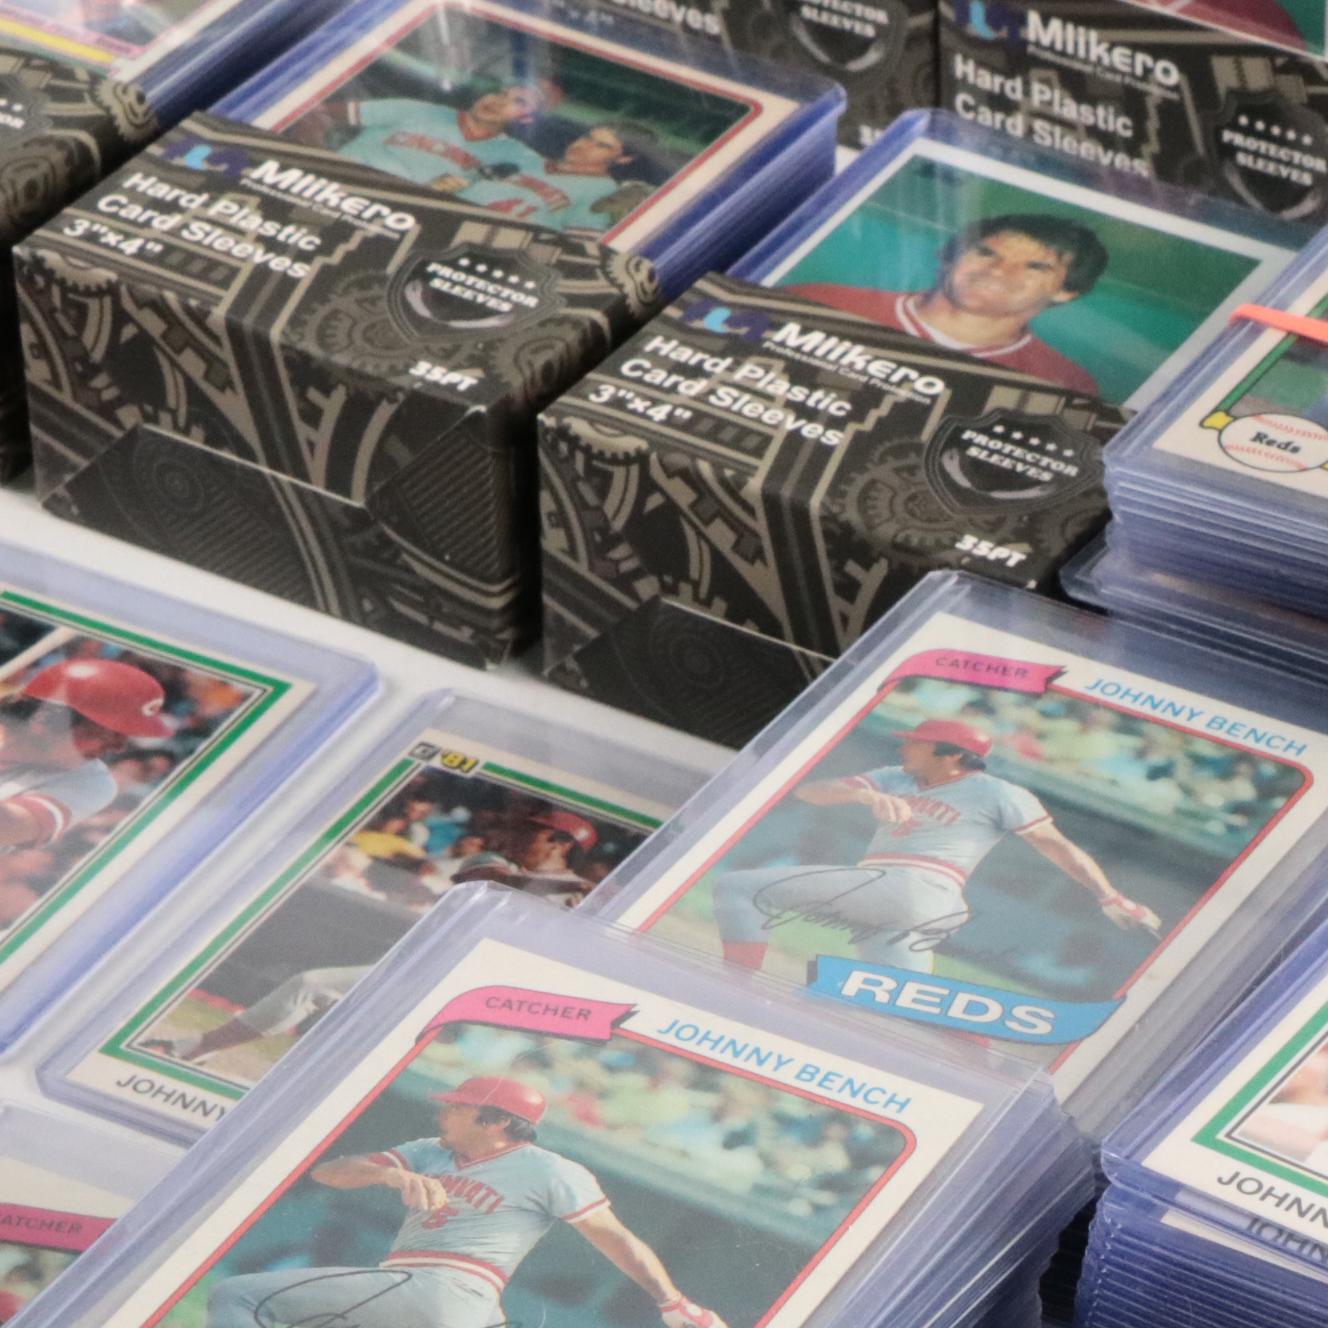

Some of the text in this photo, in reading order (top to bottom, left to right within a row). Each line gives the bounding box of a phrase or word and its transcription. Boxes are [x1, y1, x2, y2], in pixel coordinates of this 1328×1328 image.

[955, 54, 1023, 101] Hard
[1031, 81, 1133, 138] Plastic
[955, 93, 1149, 177] Card Sleeves
[1222, 129, 1327, 173] PROTECTOR
[1236, 151, 1313, 187] SLEEVES
[122, 172, 321, 251] Hard Plastic
[98, 194, 311, 279] Card Sleeves
[426, 261, 540, 308] PROTECTOR
[429, 277, 513, 313] SLEEVES
[408, 360, 478, 393] 35PT
[645, 335, 852, 417] Hard Plastic
[620, 358, 845, 446] Card Sleeves
[961, 429, 1079, 477] PROTECTOR
[966, 446, 1054, 482] SLEEVES
[1249, 430, 1302, 455] Reds
[955, 534, 1027, 568] 35PT
[935, 655, 1030, 680] CATCHER
[1085, 678, 1308, 757] JOHNNY BENCH
[485, 996, 592, 1021] CATCHER
[841, 970, 1056, 1035] REDS
[657, 1018, 912, 1115] JOHNNY BENCH
[1, 1213, 83, 1234] ATCHER
